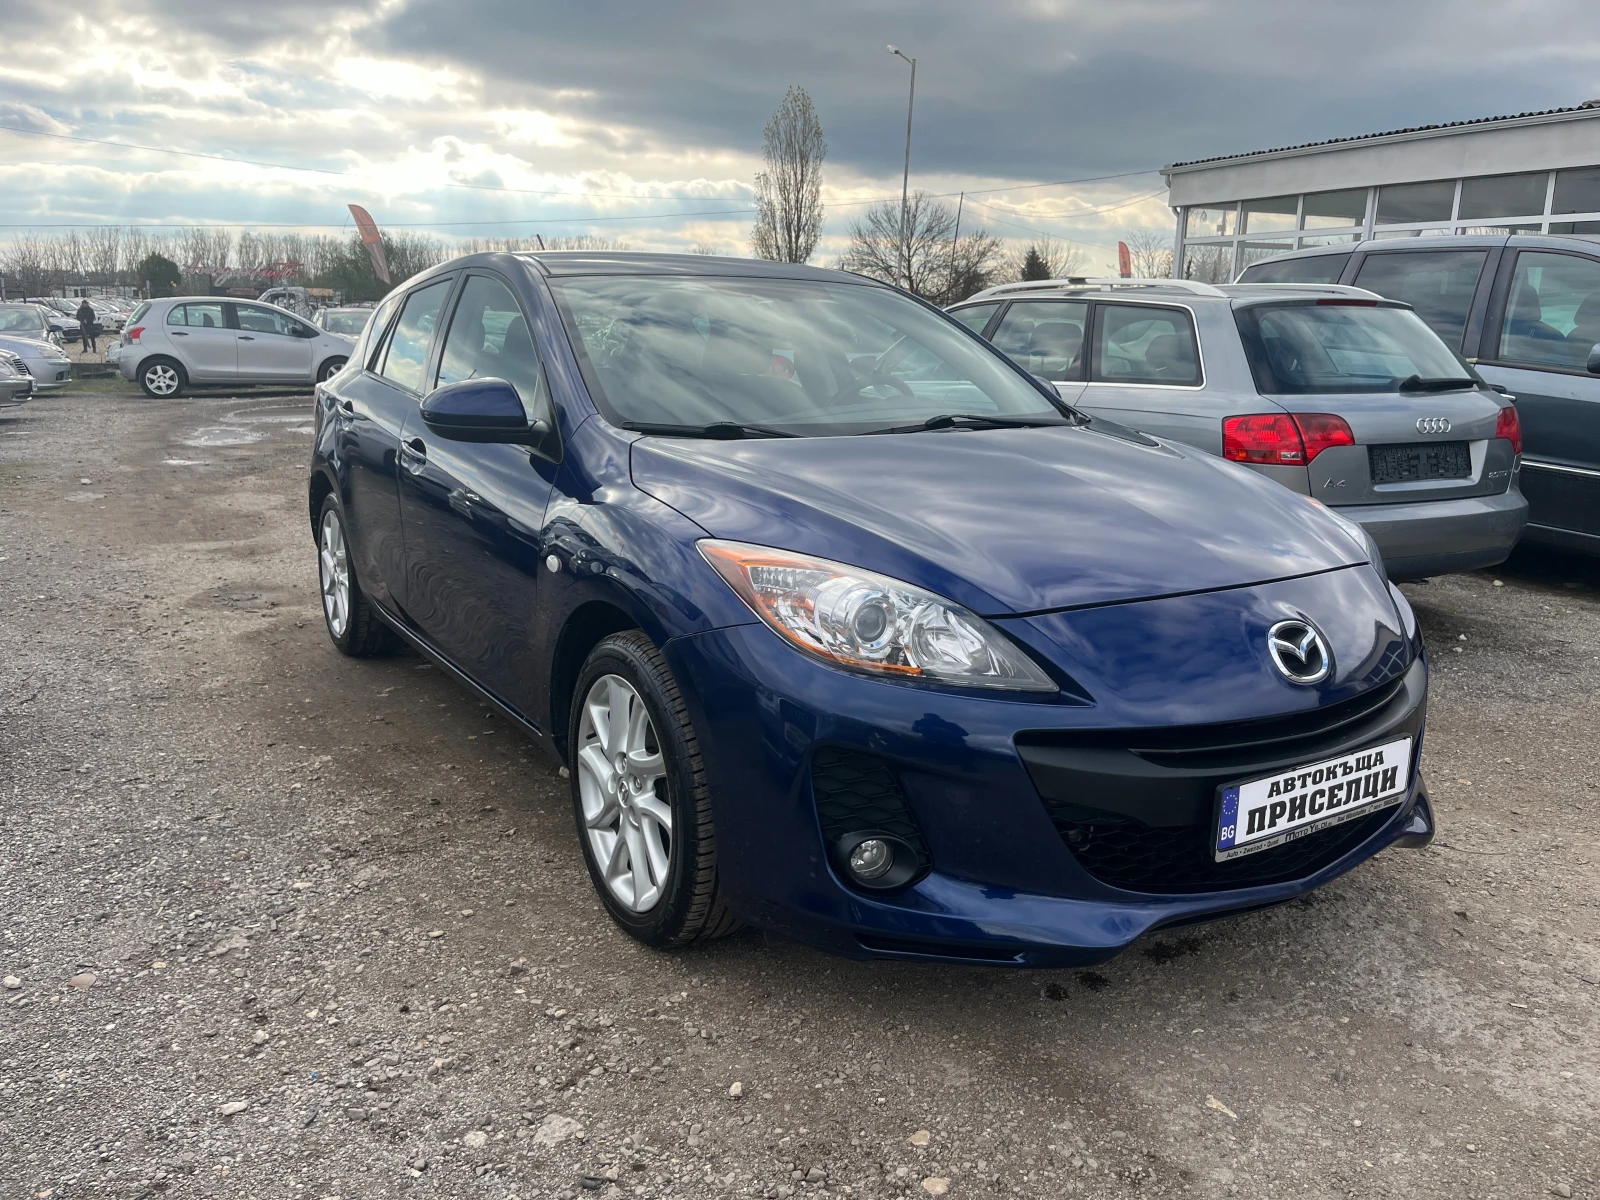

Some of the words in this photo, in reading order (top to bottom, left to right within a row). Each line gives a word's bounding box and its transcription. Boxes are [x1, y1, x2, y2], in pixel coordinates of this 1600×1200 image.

[1323, 477, 1347, 488] A4
[1267, 750, 1385, 799] АВТОКЪЩА
[1245, 765, 1399, 836] ПРИСЕЛЦИ
[1220, 825, 1235, 841] BG
